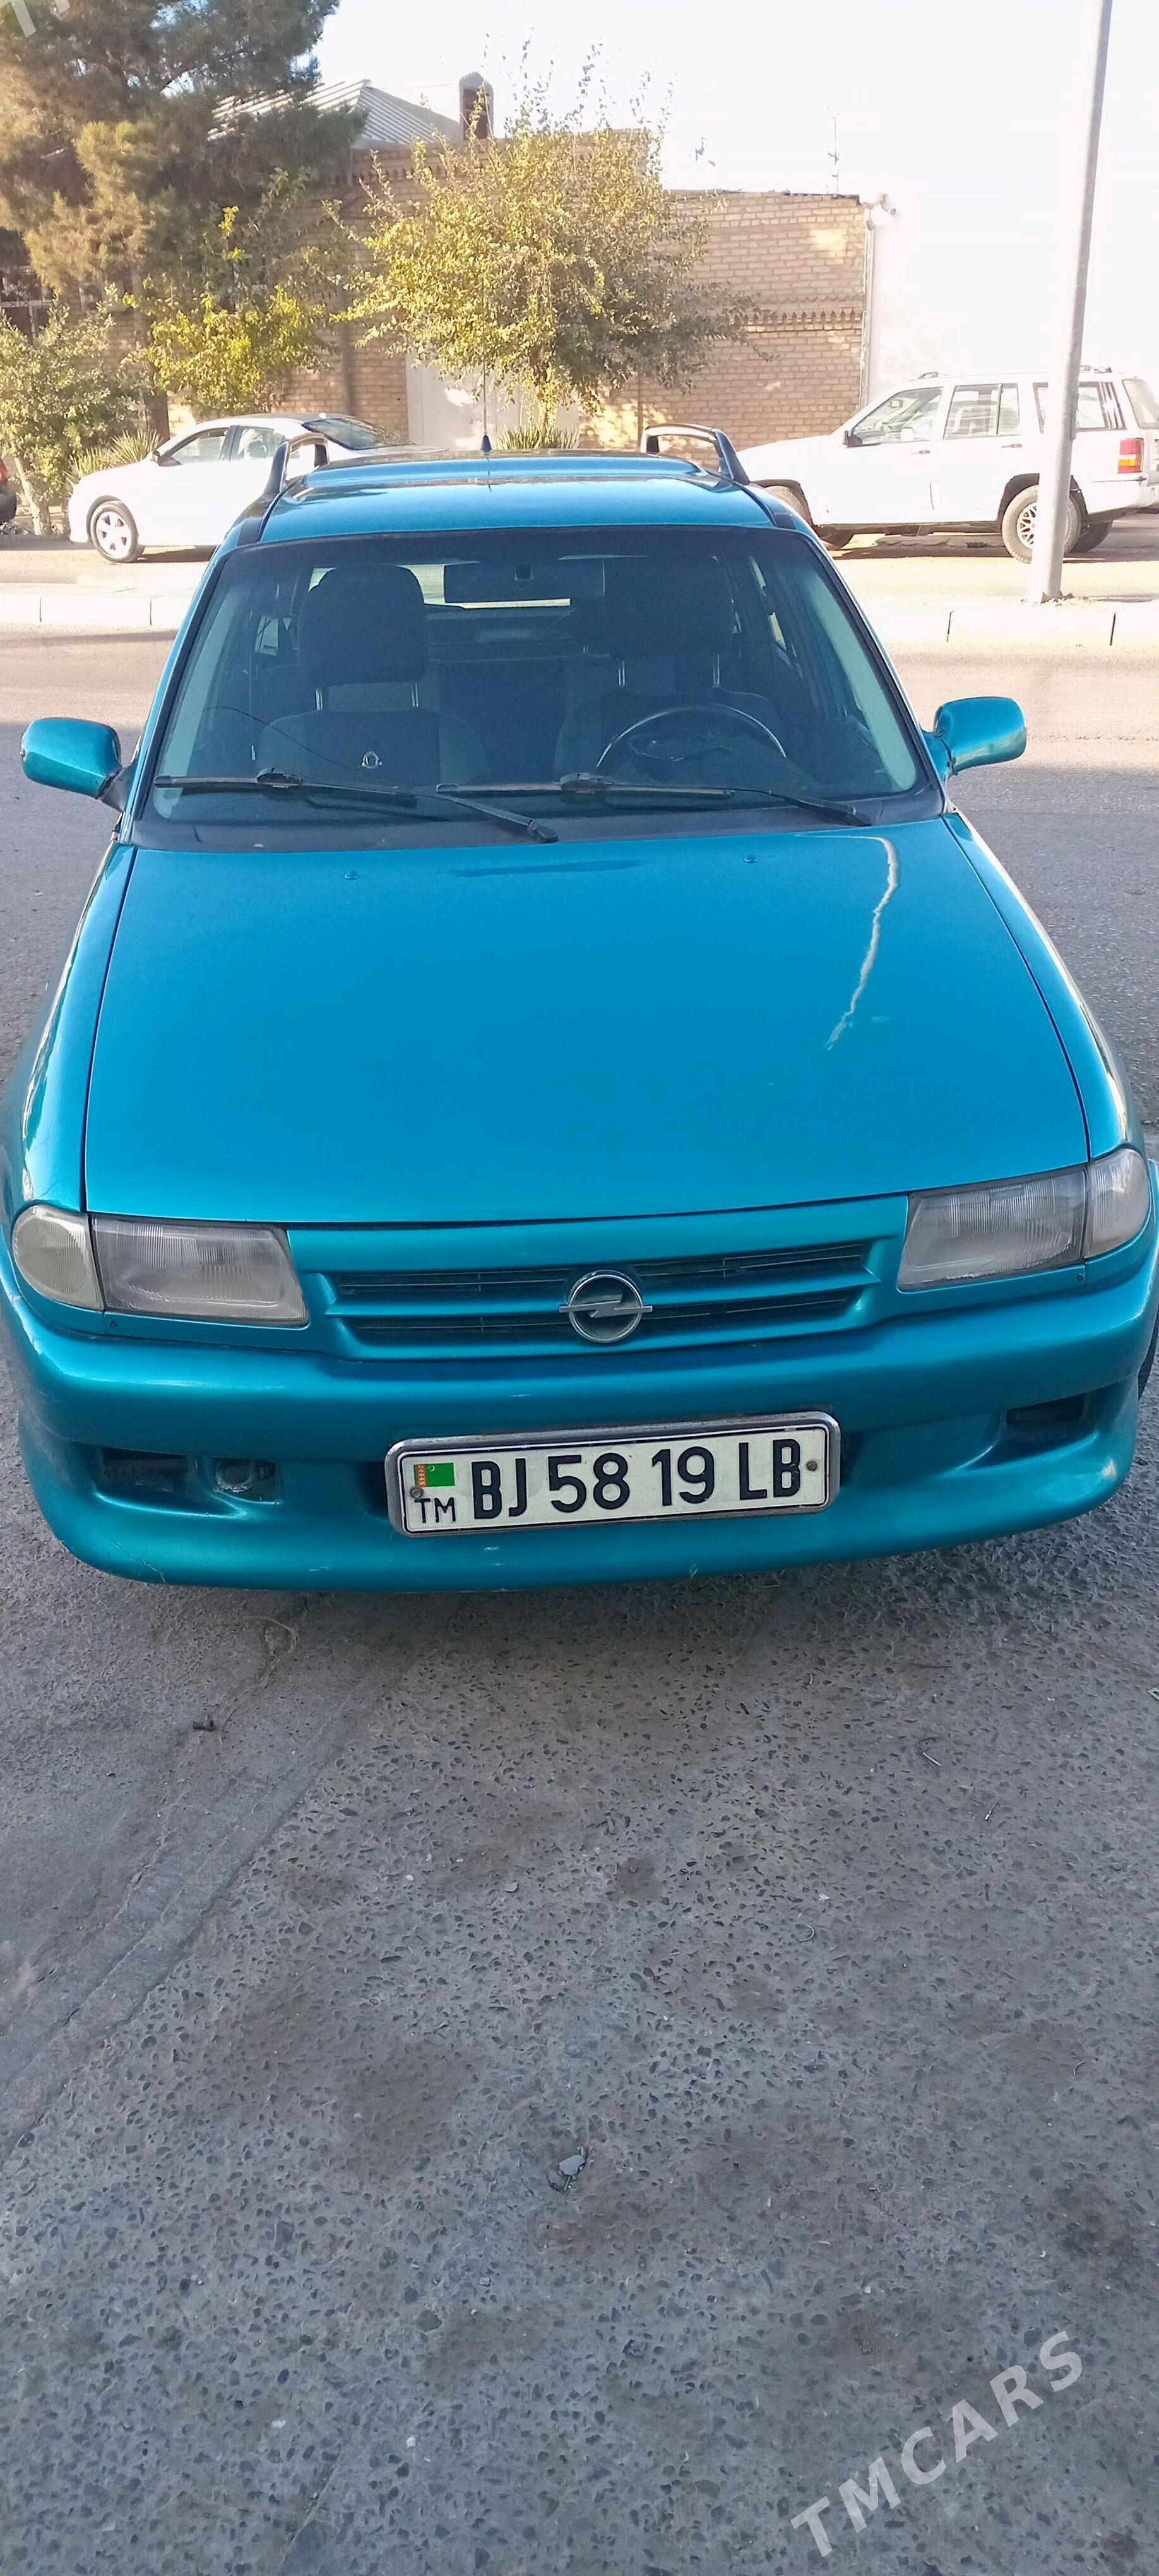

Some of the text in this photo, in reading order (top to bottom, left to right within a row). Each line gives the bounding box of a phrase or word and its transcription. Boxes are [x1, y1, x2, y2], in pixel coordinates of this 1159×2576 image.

[414, 1439, 801, 1524] TM BJ 58 19 LB
